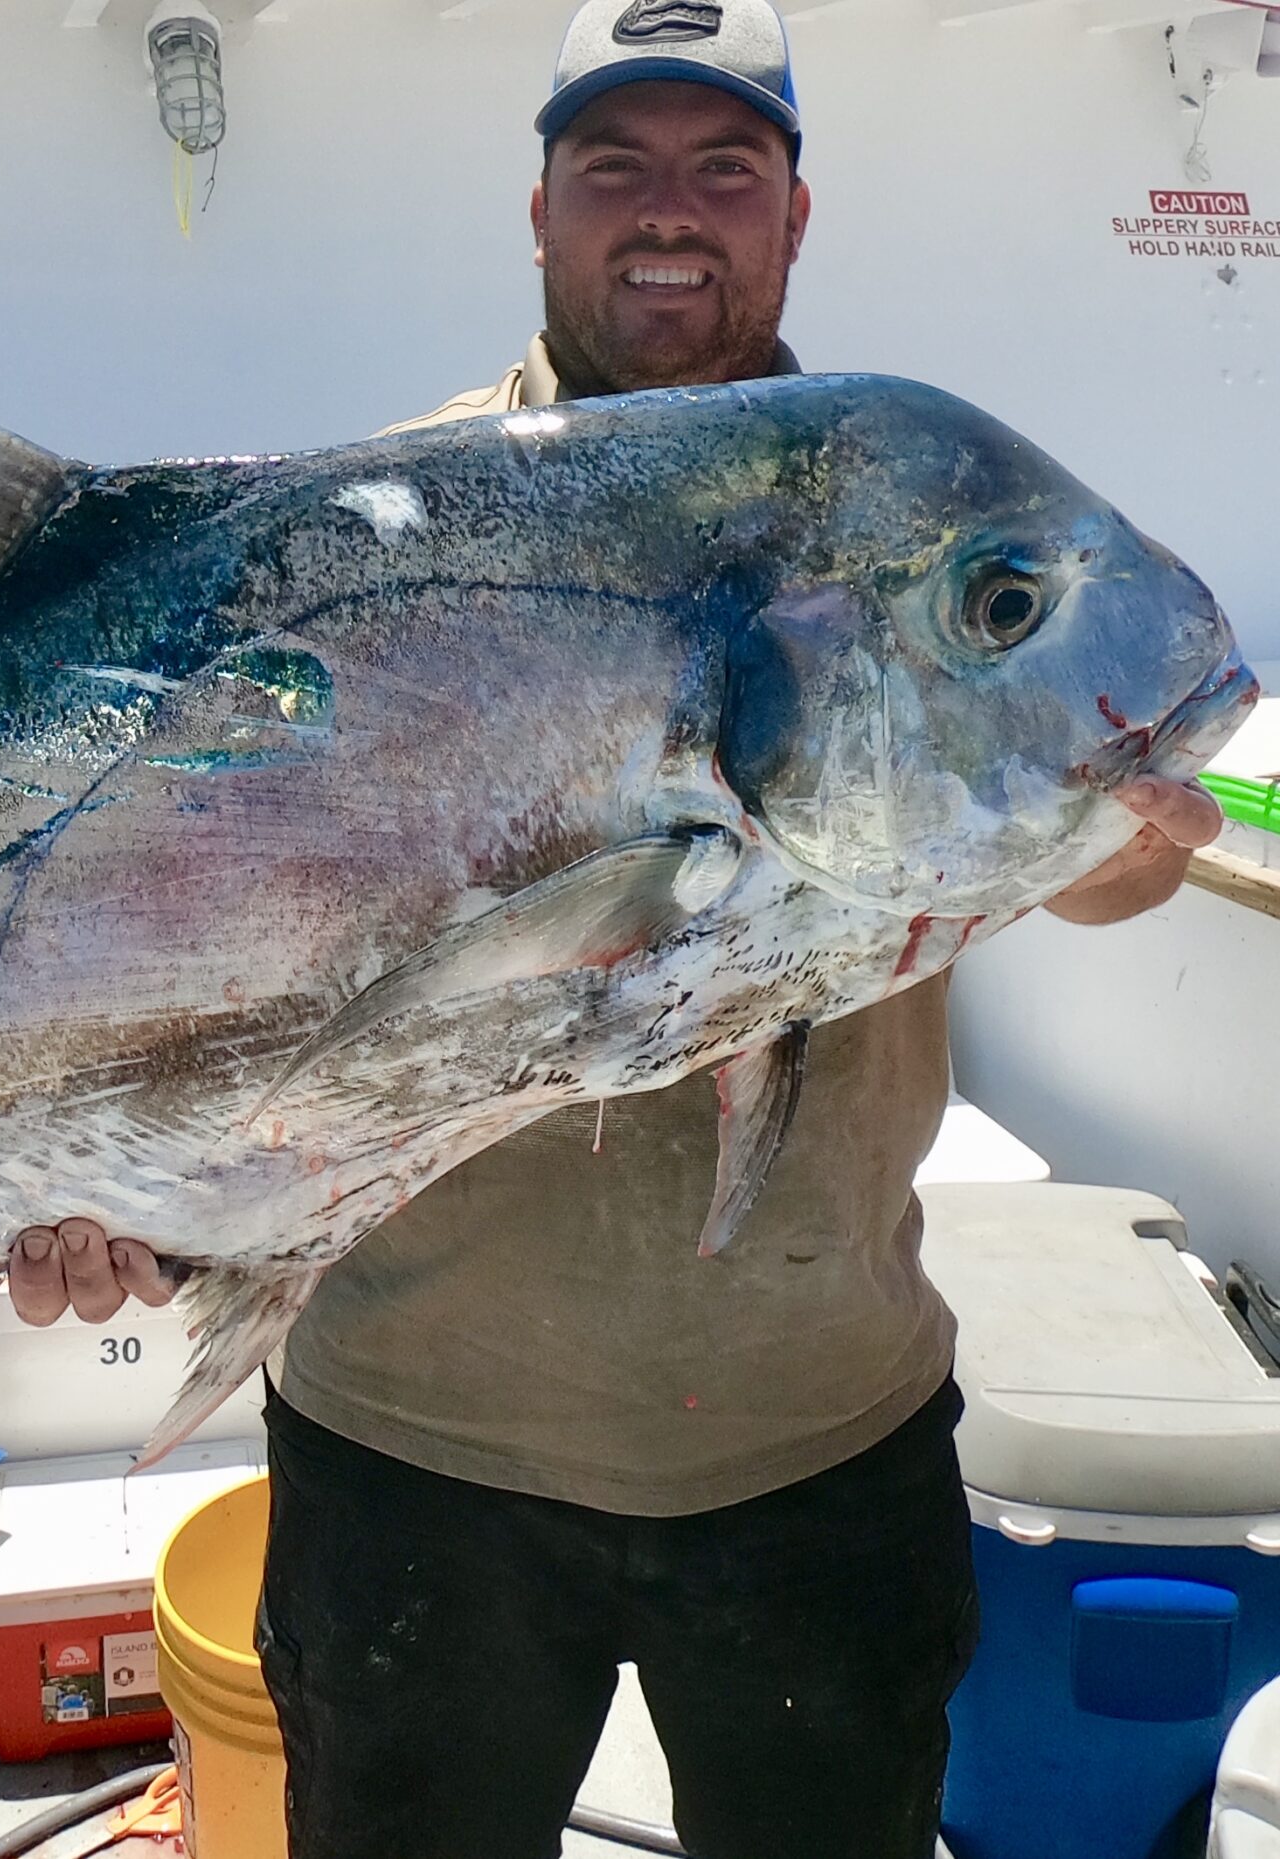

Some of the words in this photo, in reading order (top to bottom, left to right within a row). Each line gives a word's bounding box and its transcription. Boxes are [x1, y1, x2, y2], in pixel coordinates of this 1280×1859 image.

[1153, 194, 1247, 214] CAUTION
[1112, 217, 1199, 234] SLIPPERY
[1128, 240, 1180, 256] HOLD
[100, 1337, 142, 1365] 30
[111, 1643, 148, 1654] ISLAND
